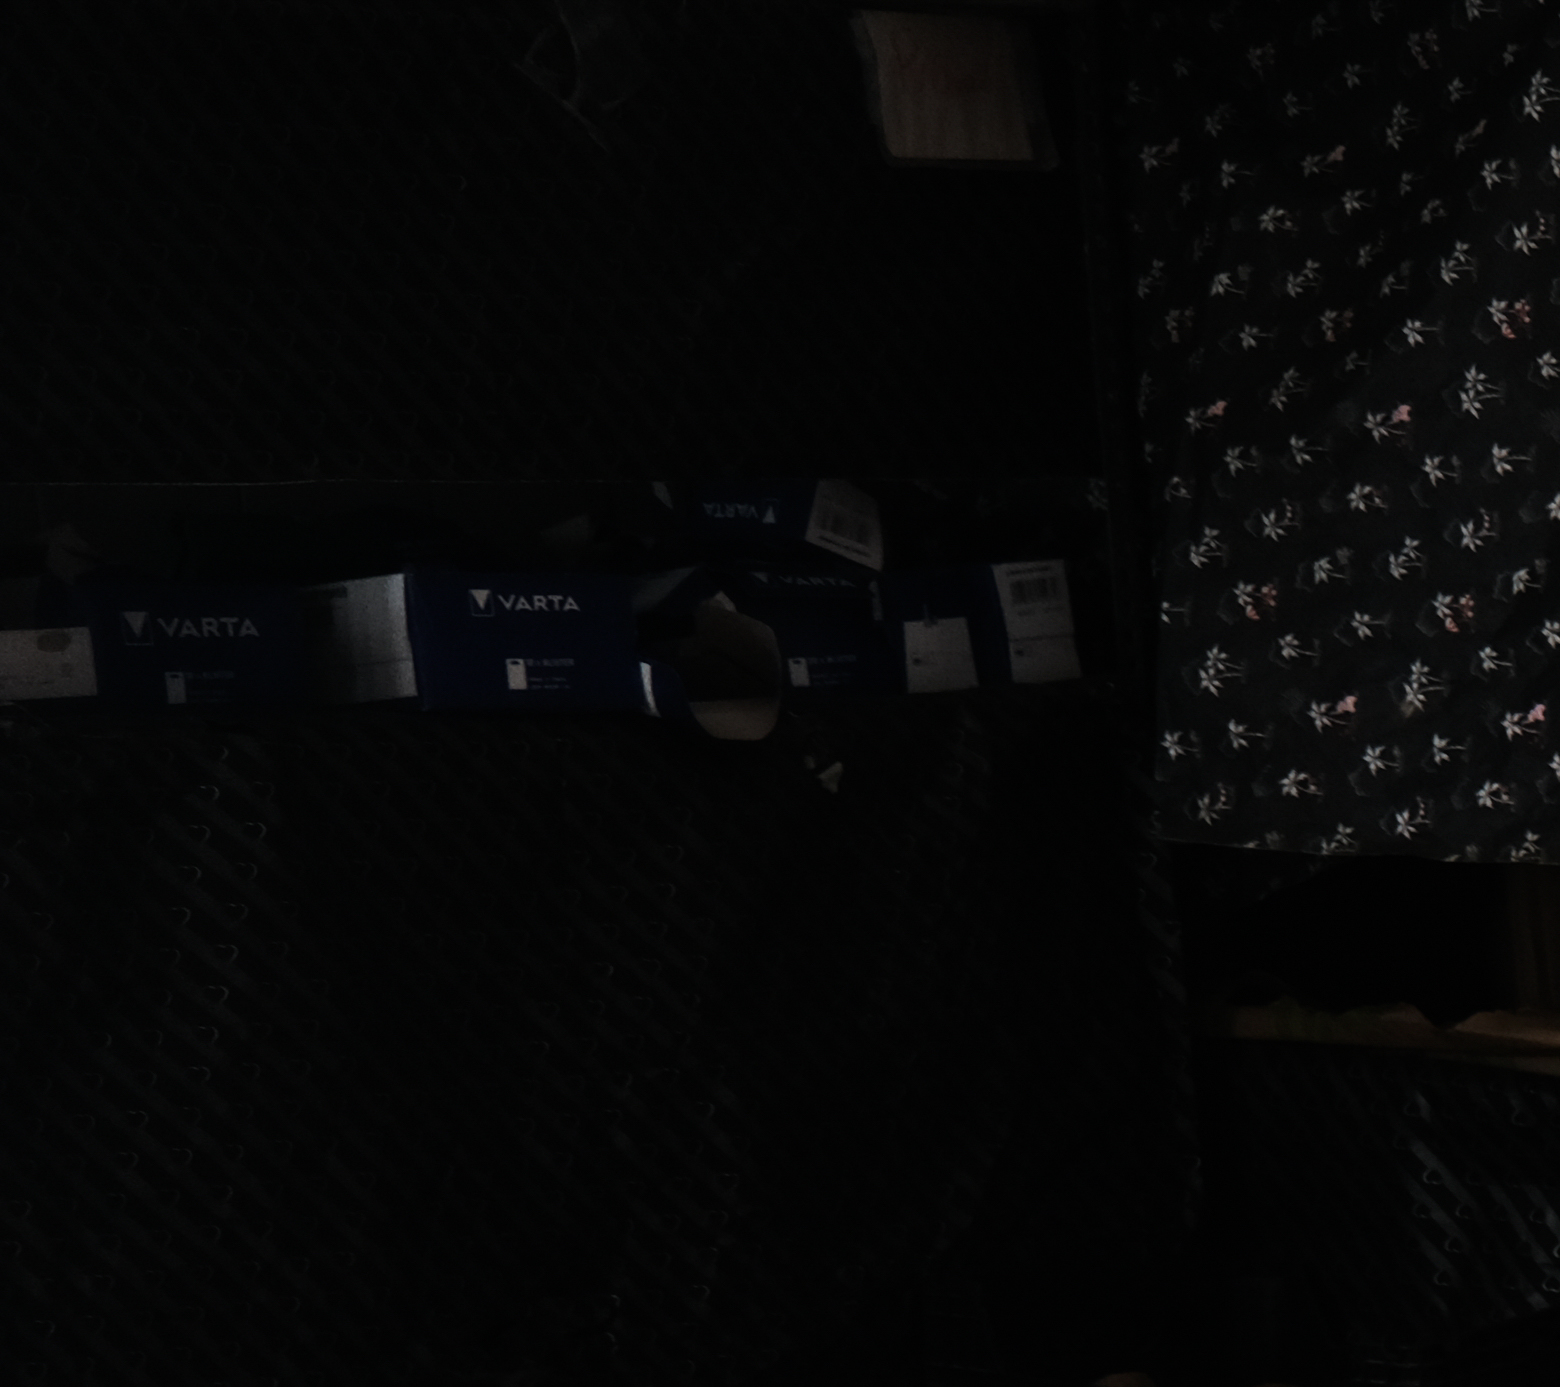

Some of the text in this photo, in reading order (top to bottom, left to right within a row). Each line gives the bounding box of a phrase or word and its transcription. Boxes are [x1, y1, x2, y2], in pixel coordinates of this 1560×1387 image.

[703, 502, 759, 519] VARTA
[498, 594, 580, 612] VARTA
[157, 617, 259, 638] VARTA
